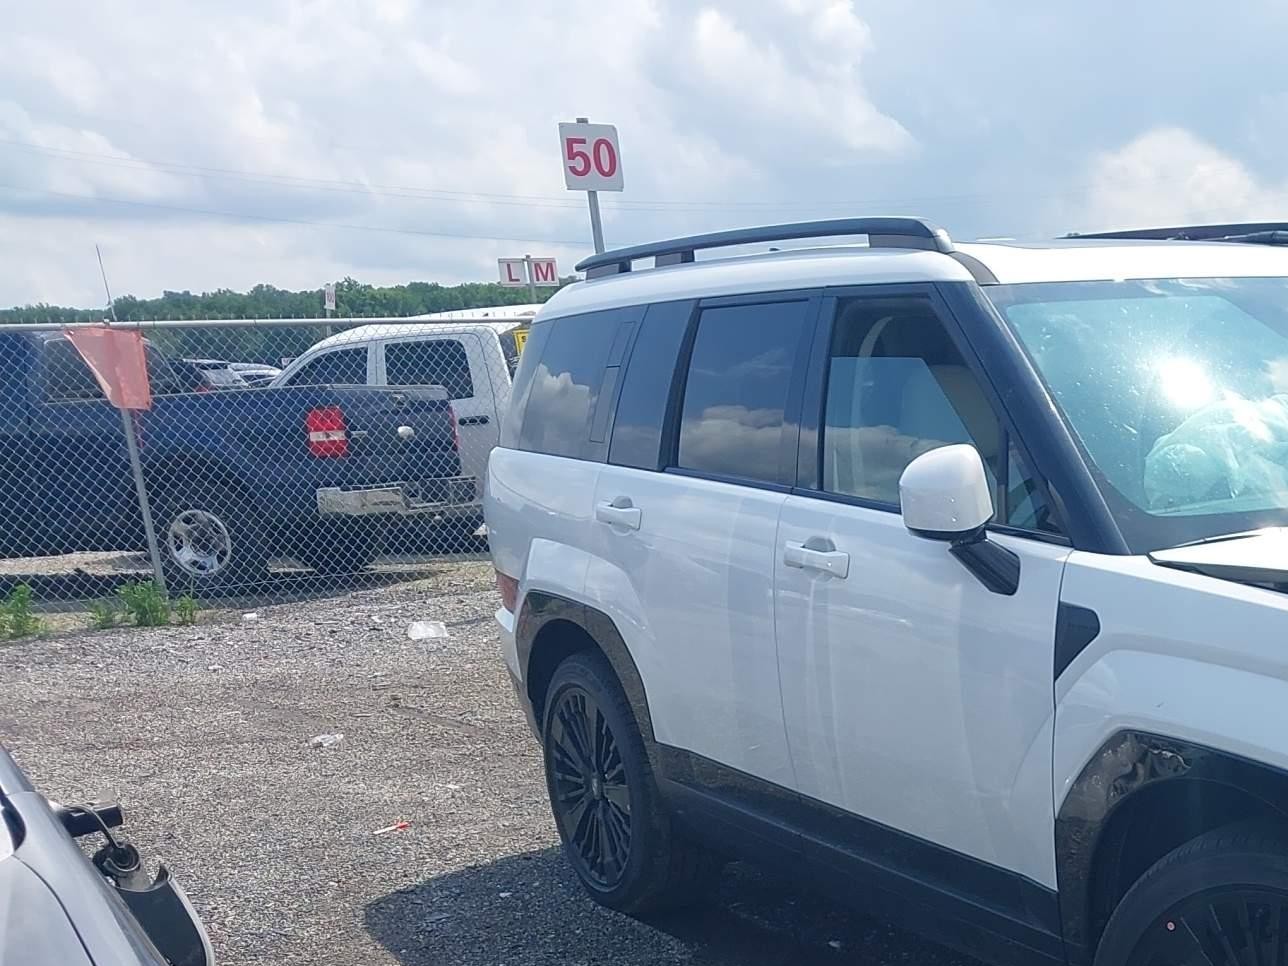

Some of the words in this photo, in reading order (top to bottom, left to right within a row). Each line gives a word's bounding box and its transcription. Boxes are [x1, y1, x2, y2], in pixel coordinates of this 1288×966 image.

[565, 137, 617, 178] 50
[506, 263, 521, 282] L
[534, 262, 556, 282] M
